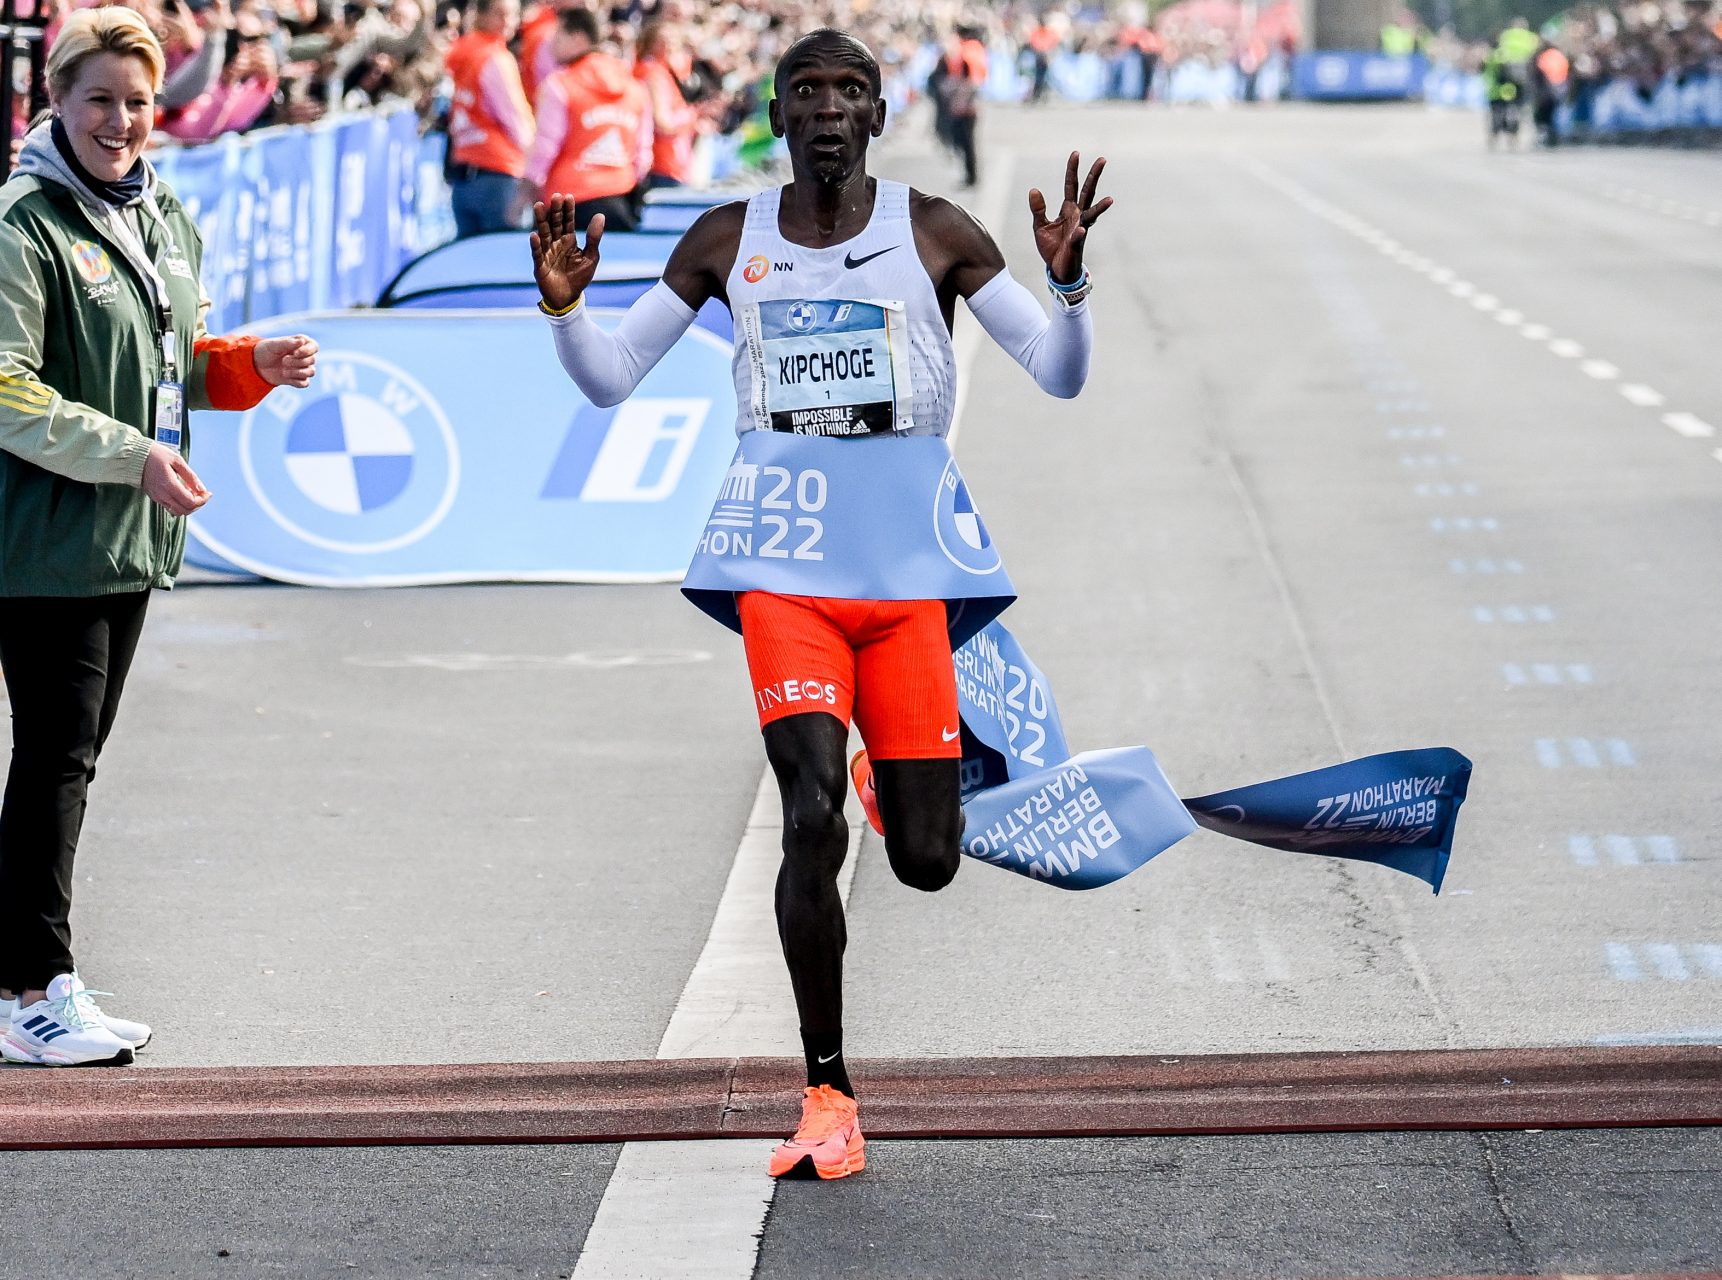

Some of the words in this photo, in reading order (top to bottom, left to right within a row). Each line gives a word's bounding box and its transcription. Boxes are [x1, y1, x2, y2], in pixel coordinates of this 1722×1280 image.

[773, 262, 794, 272] NN
[778, 347, 876, 386] KIPCHOGE
[264, 363, 420, 422] BMW
[825, 390, 831, 400] 1
[791, 407, 854, 426] IMPOSSIBLE
[793, 426, 803, 436] IS
[804, 421, 851, 437] NOTHING
[761, 466, 828, 513] 20
[758, 515, 824, 561] 22
[952, 646, 996, 692] ERLIN
[757, 680, 836, 711] INEOS
[1005, 665, 1048, 720] 20
[1006, 711, 1047, 768] 22
[961, 764, 1089, 857] MARATHO
[1303, 793, 1351, 830] 22
[1350, 775, 1446, 813] MARATHON
[1375, 799, 1437, 830] BERLIN
[1013, 786, 1102, 863] BERLIN
[1029, 810, 1122, 879] BMW
